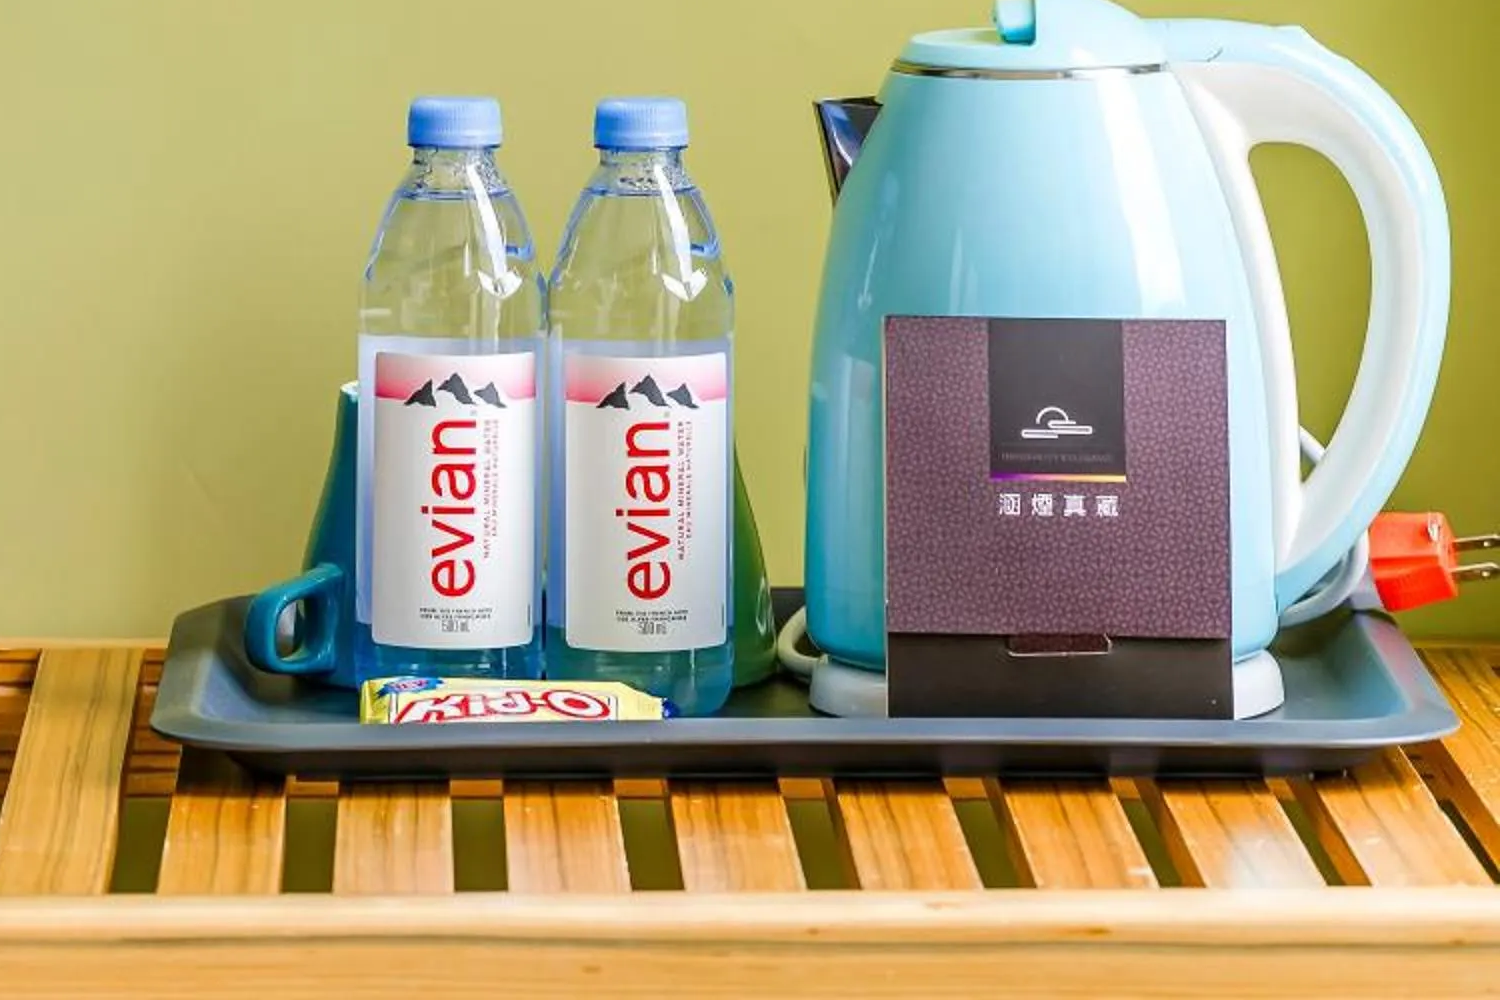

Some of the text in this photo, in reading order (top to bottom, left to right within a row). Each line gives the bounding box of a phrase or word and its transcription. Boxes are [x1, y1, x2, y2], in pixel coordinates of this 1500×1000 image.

[421, 420, 477, 597] evian
[615, 422, 672, 601] evian
[677, 461, 685, 507] MINERAL
[677, 512, 685, 560] NATURAL
